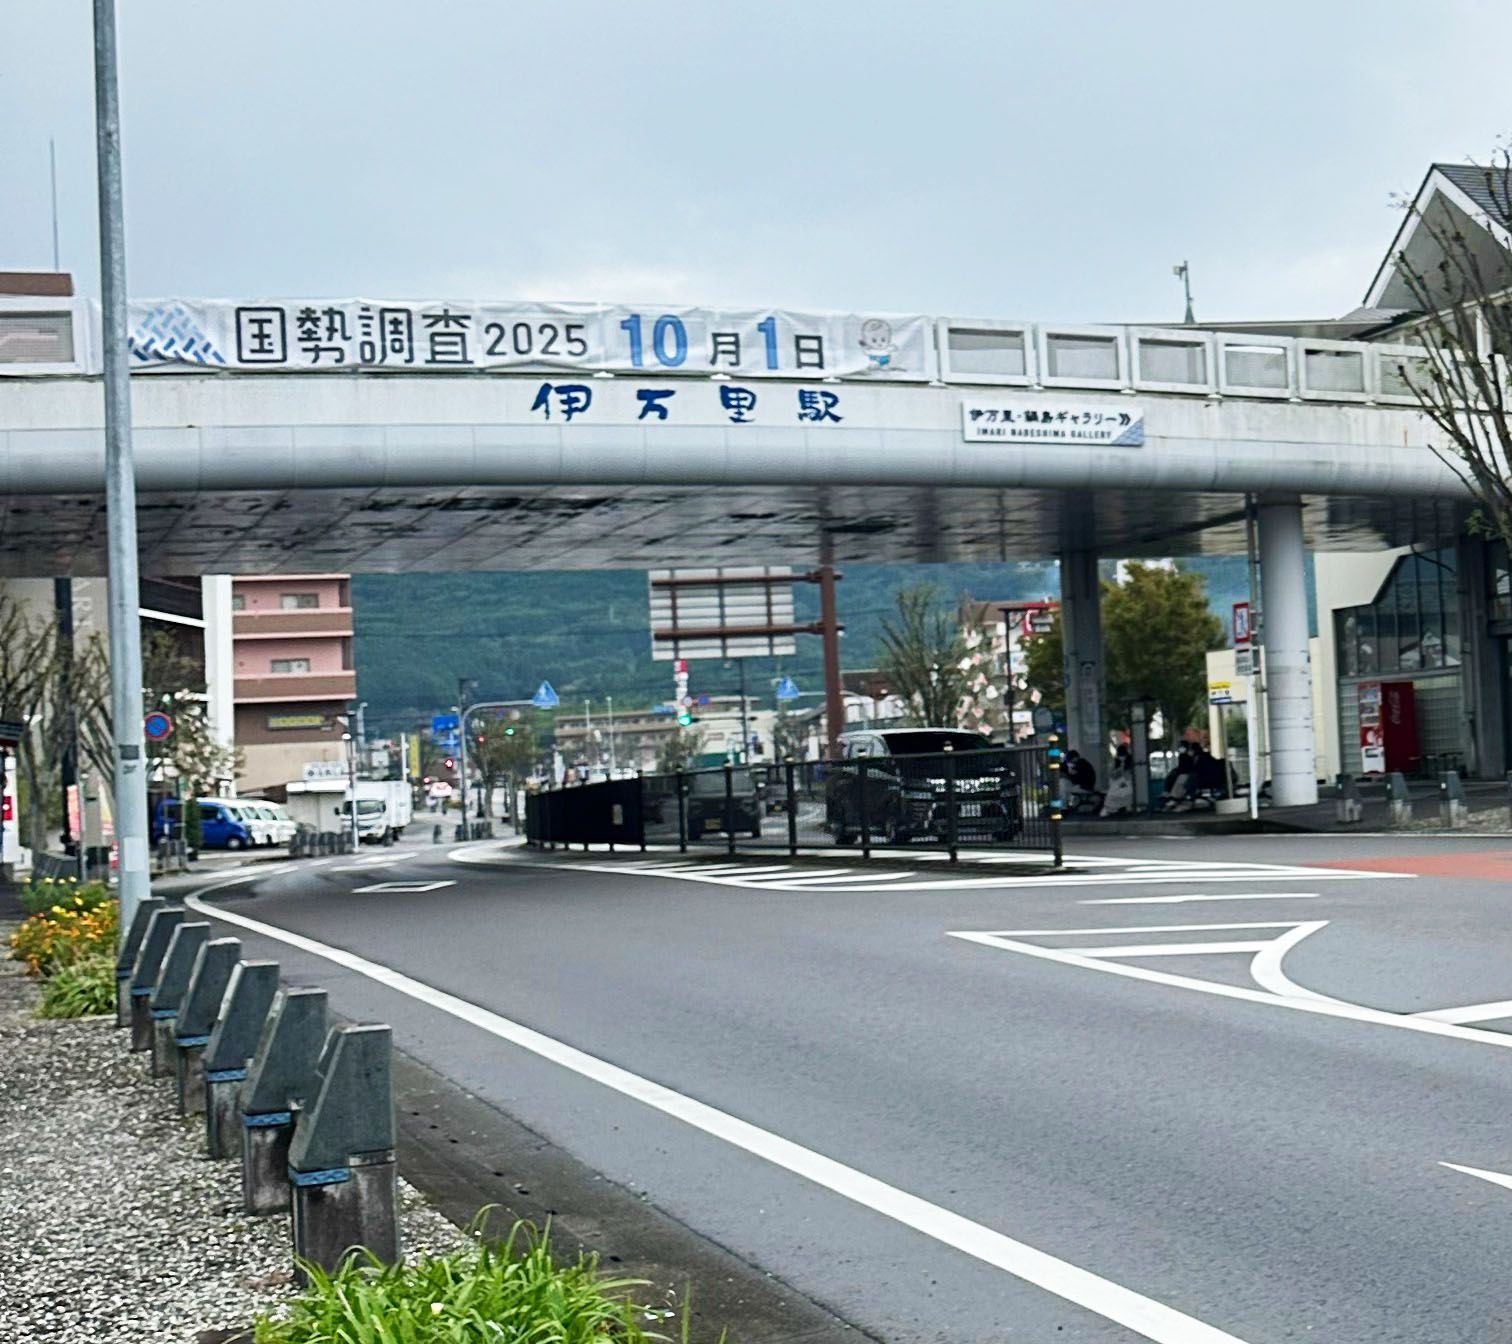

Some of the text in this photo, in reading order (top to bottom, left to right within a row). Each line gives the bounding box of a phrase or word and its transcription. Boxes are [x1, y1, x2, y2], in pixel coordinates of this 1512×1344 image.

[235, 307, 824, 369] 国勢調査2025 10月1日
[533, 383, 842, 423] 伊万里駅
